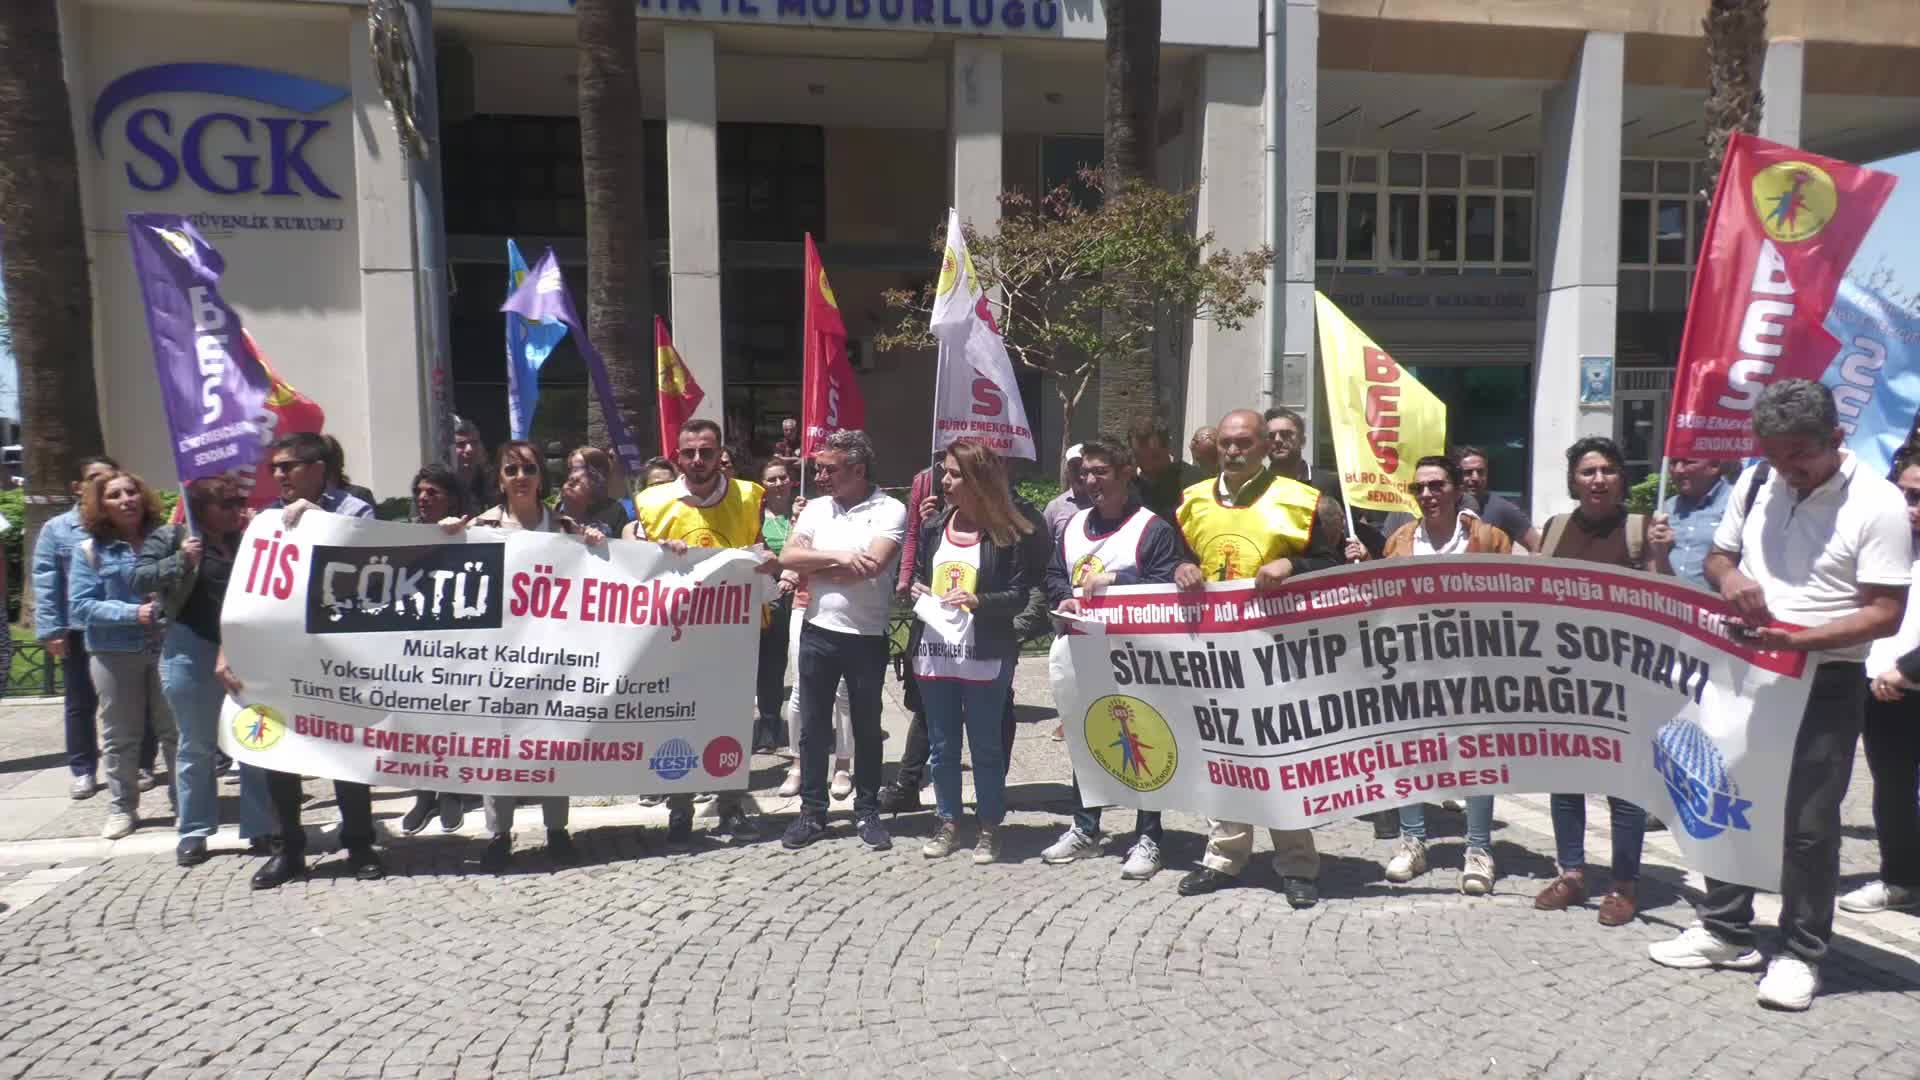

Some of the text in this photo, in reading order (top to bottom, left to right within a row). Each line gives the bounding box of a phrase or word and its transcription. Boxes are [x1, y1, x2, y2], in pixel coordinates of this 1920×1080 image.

[124, 107, 343, 200] SGK
[1363, 346, 1401, 474] BES
[245, 531, 752, 641] TİS ÇÖKTÜ SÖZ Emekçinin!
[1214, 604, 1239, 623] Adı
[1243, 592, 1307, 619] Altında
[1312, 576, 1407, 609] Emekçiler
[1411, 577, 1435, 594] ve
[1439, 573, 1536, 593] Yoksullar
[1542, 577, 1605, 602] Açlığa
[1609, 584, 1693, 625] Mahkum
[321, 659, 670, 696] Yoksulluk Sınırı Üzerinde Bir Ücret!
[403, 639, 600, 668] Mülakat Kaldırılsın!
[1110, 641, 1246, 689] SİZLERİN
[1252, 628, 1347, 686] YİYİP
[1358, 608, 1542, 680] İÇTİĞİNİZ
[1556, 622, 1709, 704] SOFRAYI
[290, 679, 696, 722] Tüm Ek Ödemeler Taban Maaşa Eklensin!
[1193, 666, 1628, 747] BİZ KALDIRMAYACAĞIZ!
[295, 714, 644, 763] BÜRO EMEKÇİLERİ SENDİKASI
[649, 756, 700, 770] KESK
[719, 751, 739, 768] PSI
[1207, 728, 1622, 792] BÜRO EMEKÇİLERİ SENDİKASI
[375, 756, 555, 784] İZMİR ŞUBESİ
[1303, 765, 1511, 817] İZMİR ŞUBESİ
